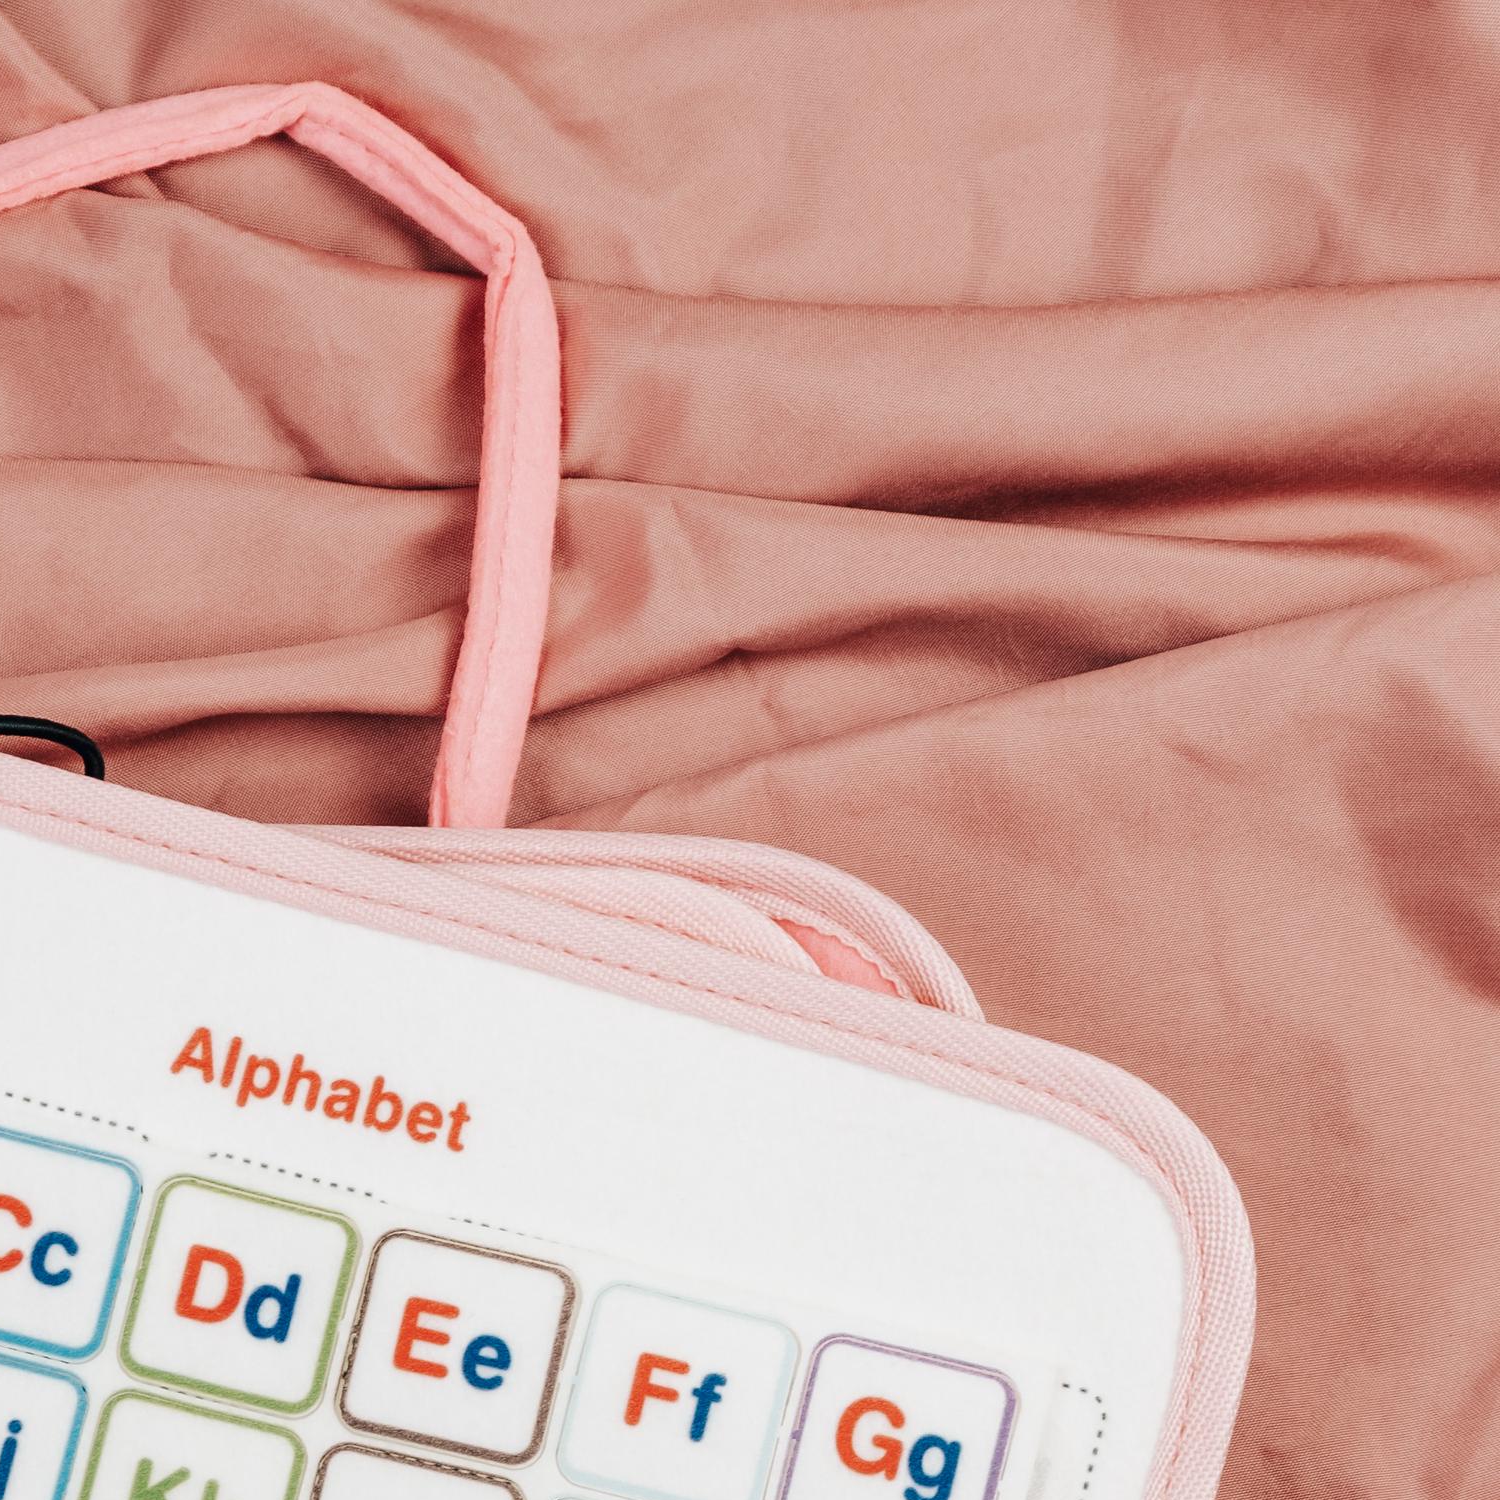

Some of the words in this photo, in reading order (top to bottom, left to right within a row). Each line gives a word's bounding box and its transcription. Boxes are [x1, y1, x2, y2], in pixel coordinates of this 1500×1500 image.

[171, 1027, 470, 1152] Alphabet
[175, 1244, 301, 1343] Dd
[393, 1297, 511, 1390] Ee
[624, 1353, 725, 1441] Ff
